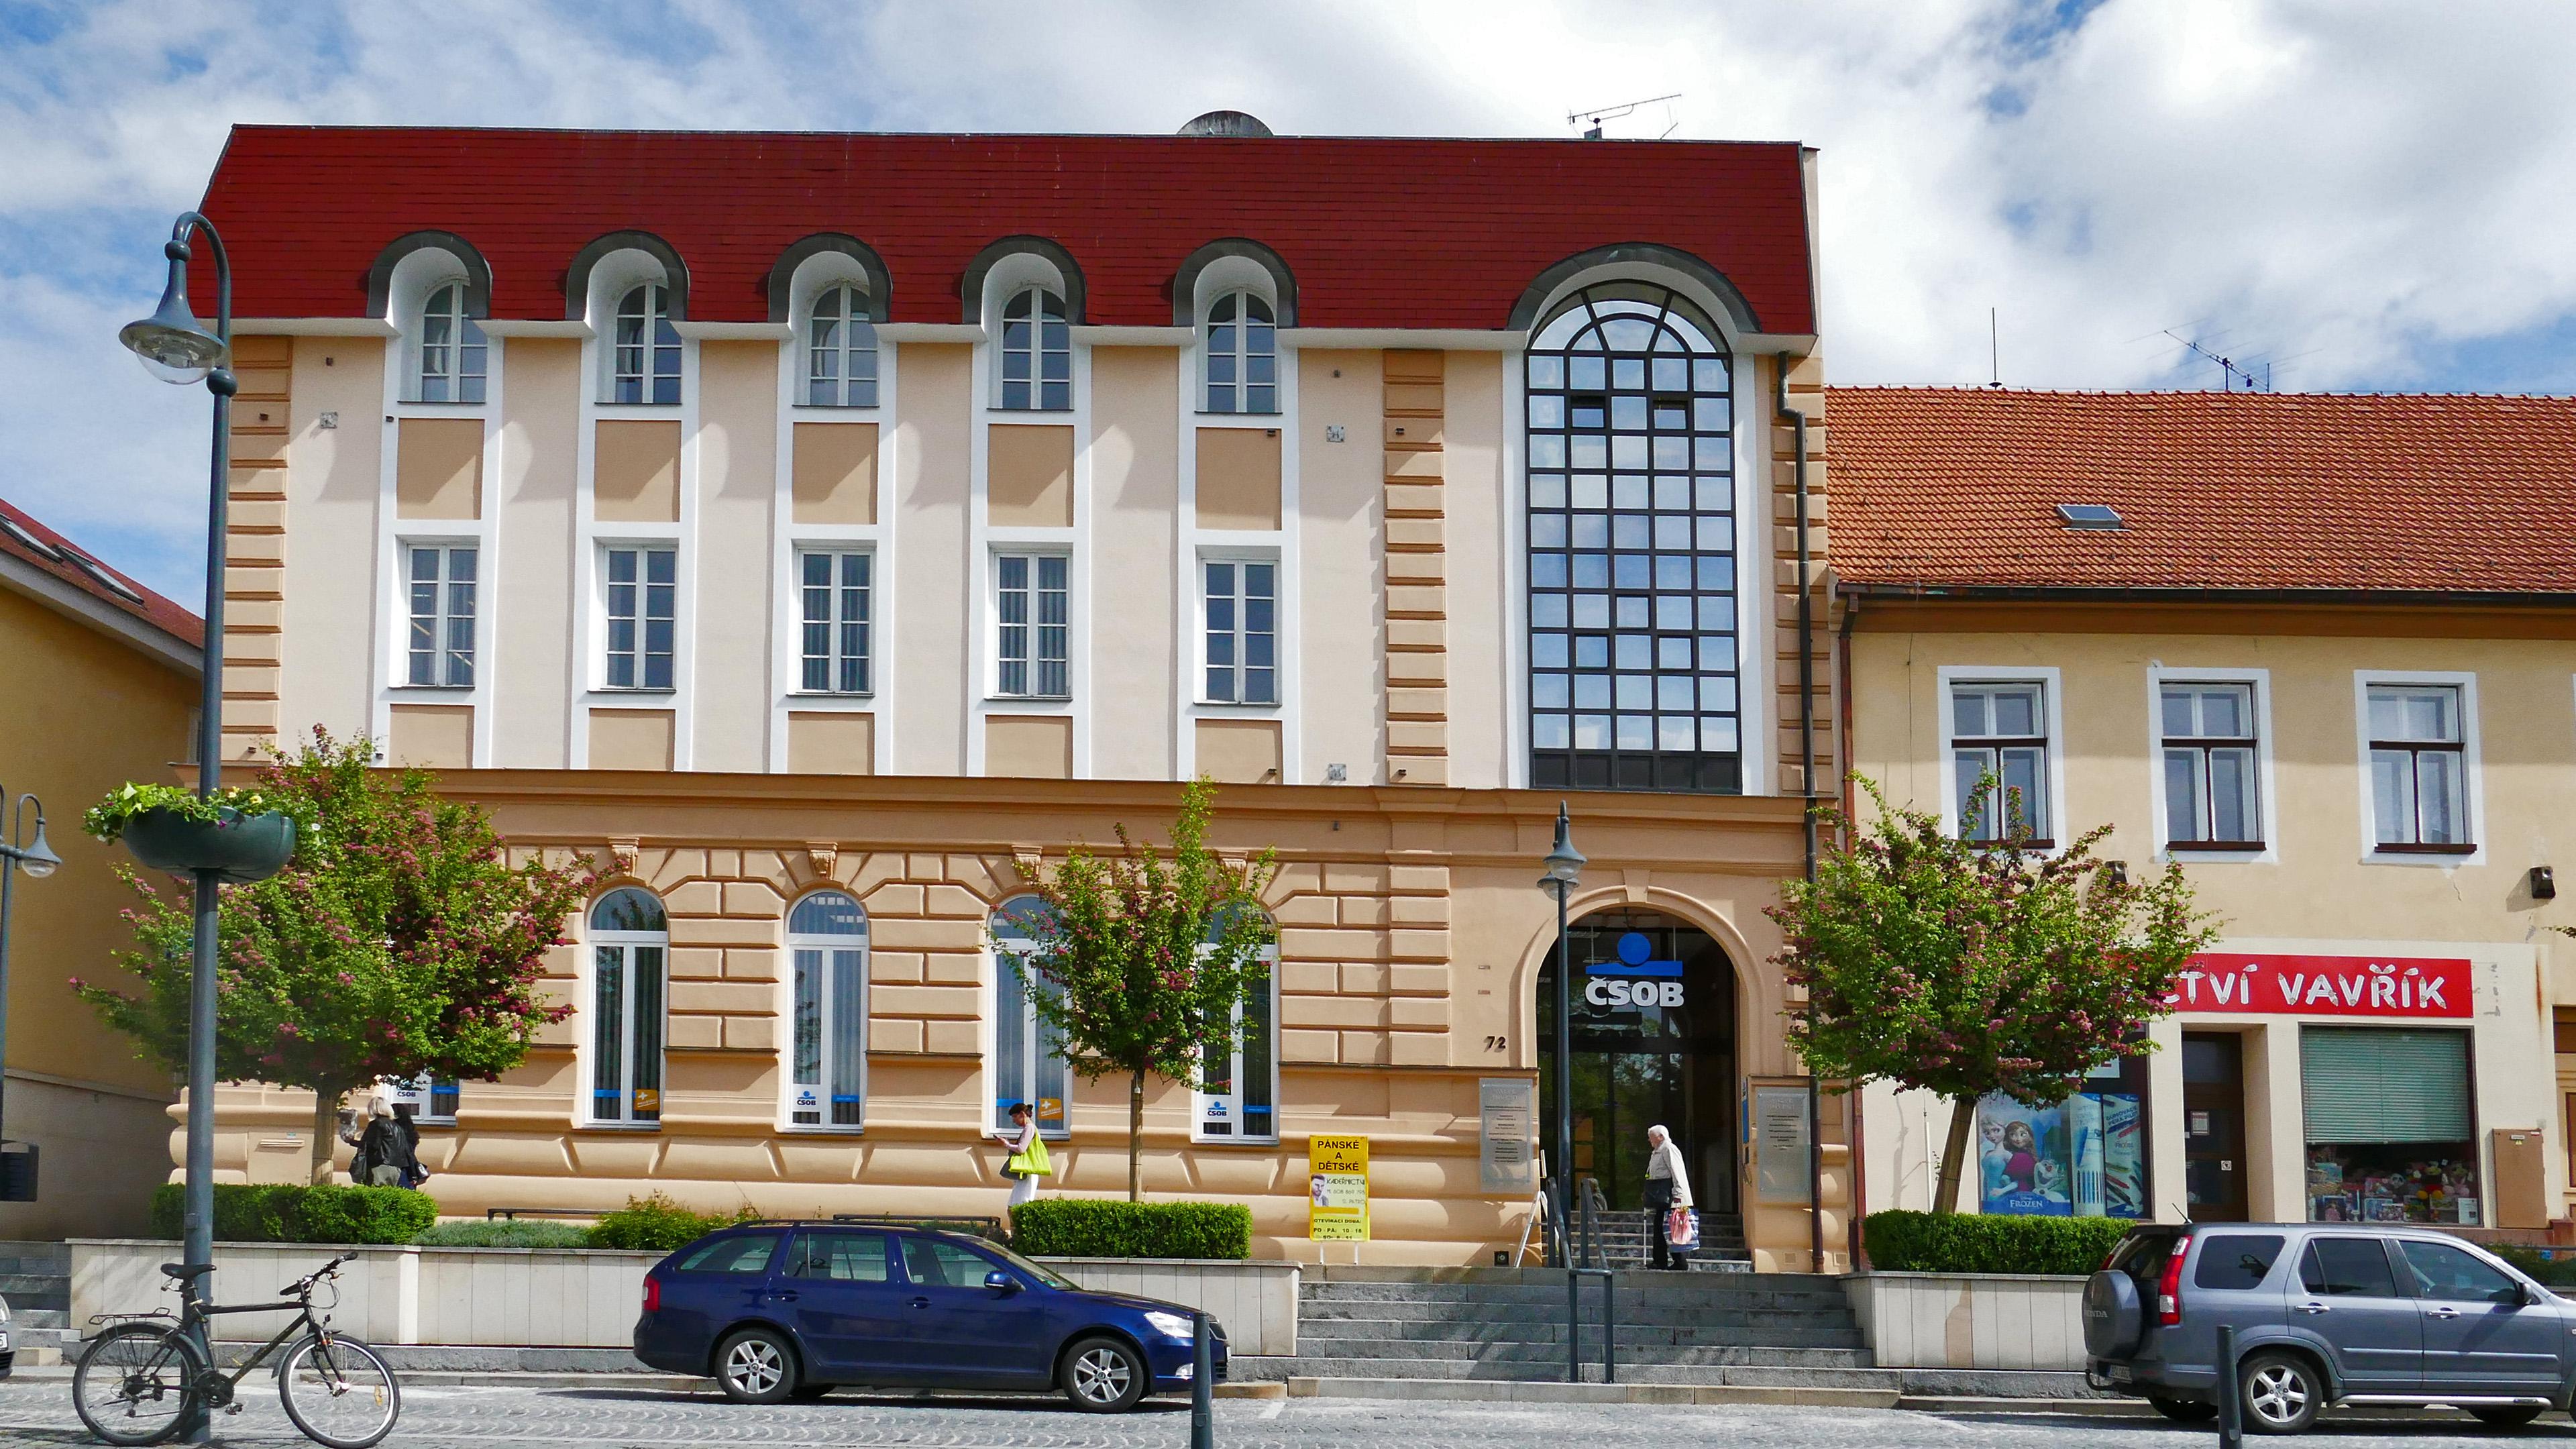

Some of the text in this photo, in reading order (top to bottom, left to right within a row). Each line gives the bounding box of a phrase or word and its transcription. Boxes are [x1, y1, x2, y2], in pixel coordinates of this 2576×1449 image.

[1585, 975, 1684, 1007] ČSOB
[2277, 963, 2447, 1009] VAVŘÍK
[1487, 1036, 1506, 1049] 72
[1318, 1139, 1360, 1149] PÁNSKÉ
[1335, 1151, 1343, 1160] A
[1318, 1161, 1359, 1171] DĚTSKÉ
[2010, 1199, 2043, 1208] FROZEN
